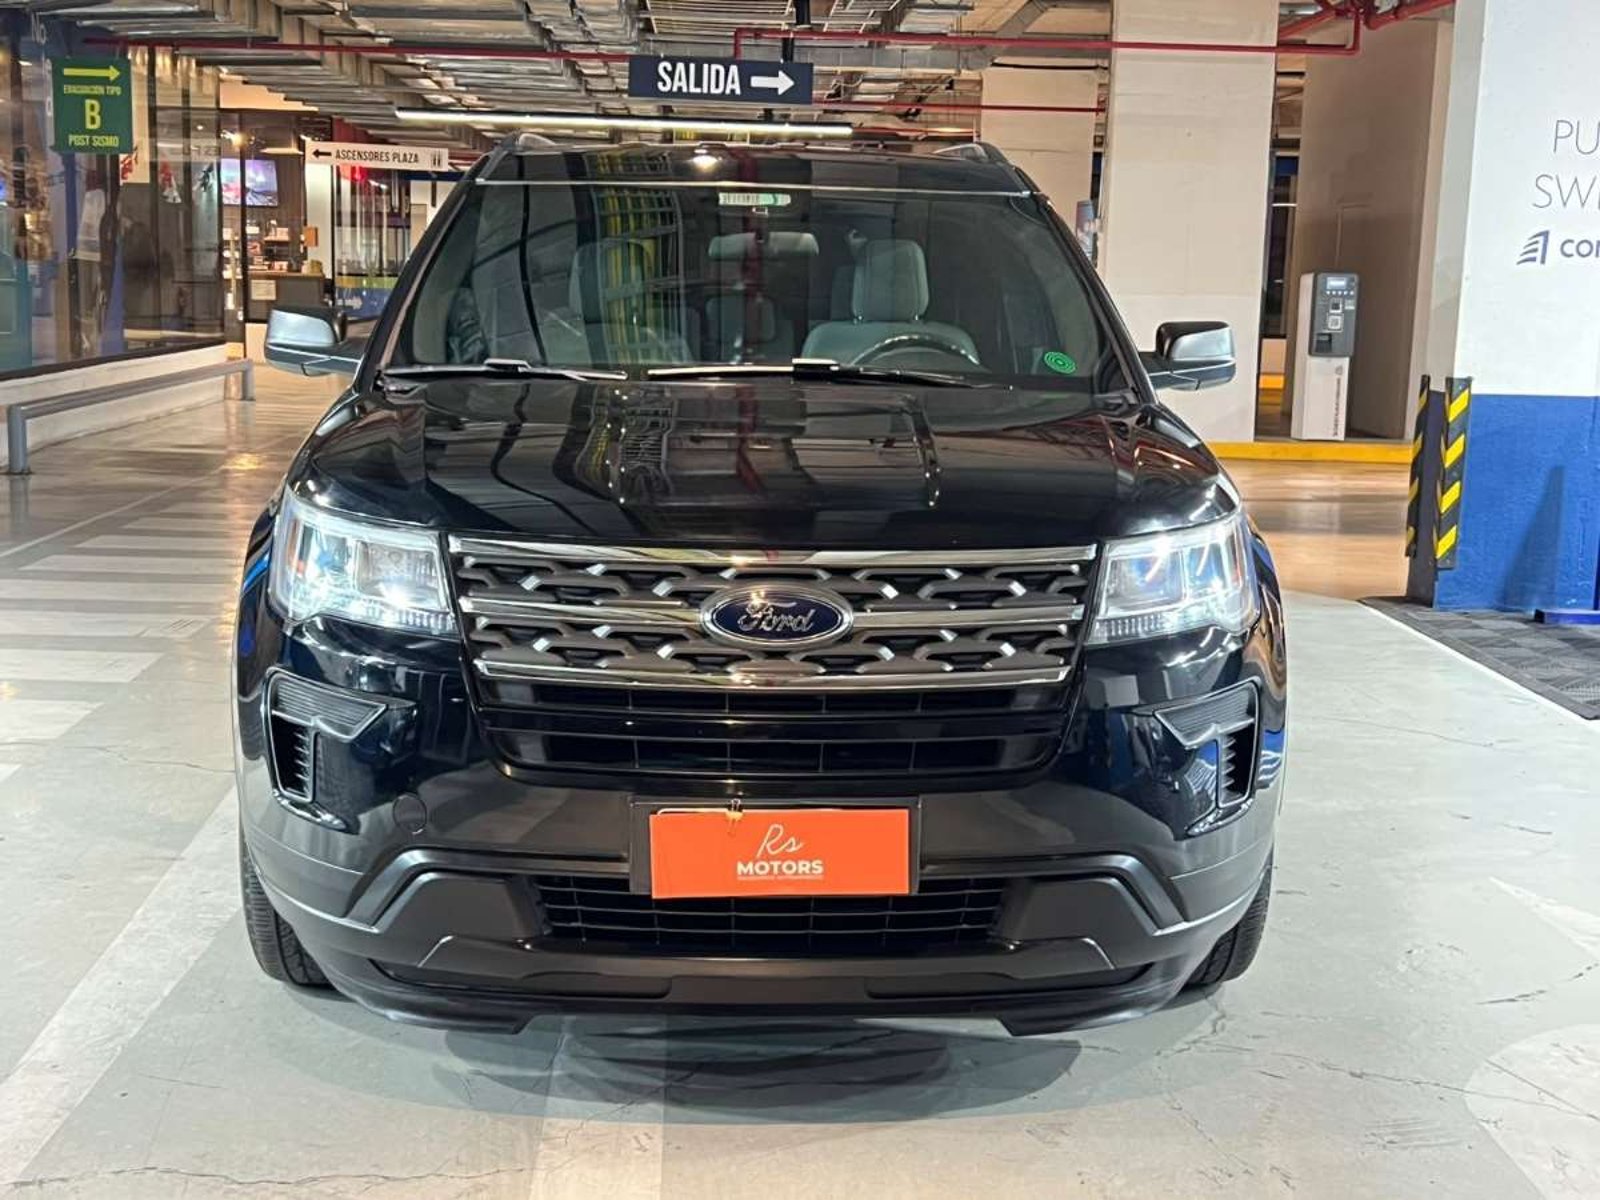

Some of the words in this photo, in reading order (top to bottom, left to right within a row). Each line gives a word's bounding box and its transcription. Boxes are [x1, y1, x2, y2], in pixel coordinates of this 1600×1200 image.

[657, 61, 741, 95] SALIDA
[84, 98, 101, 130] B
[68, 133, 90, 147] POST
[92, 134, 120, 147] SISMO
[335, 148, 390, 162] ASCENSORES
[391, 152, 419, 164] PLAZA
[1532, 173, 1600, 211] SW
[737, 600, 816, 632] Ford
[756, 823, 803, 858] Rs
[736, 859, 824, 876] MOTORS
